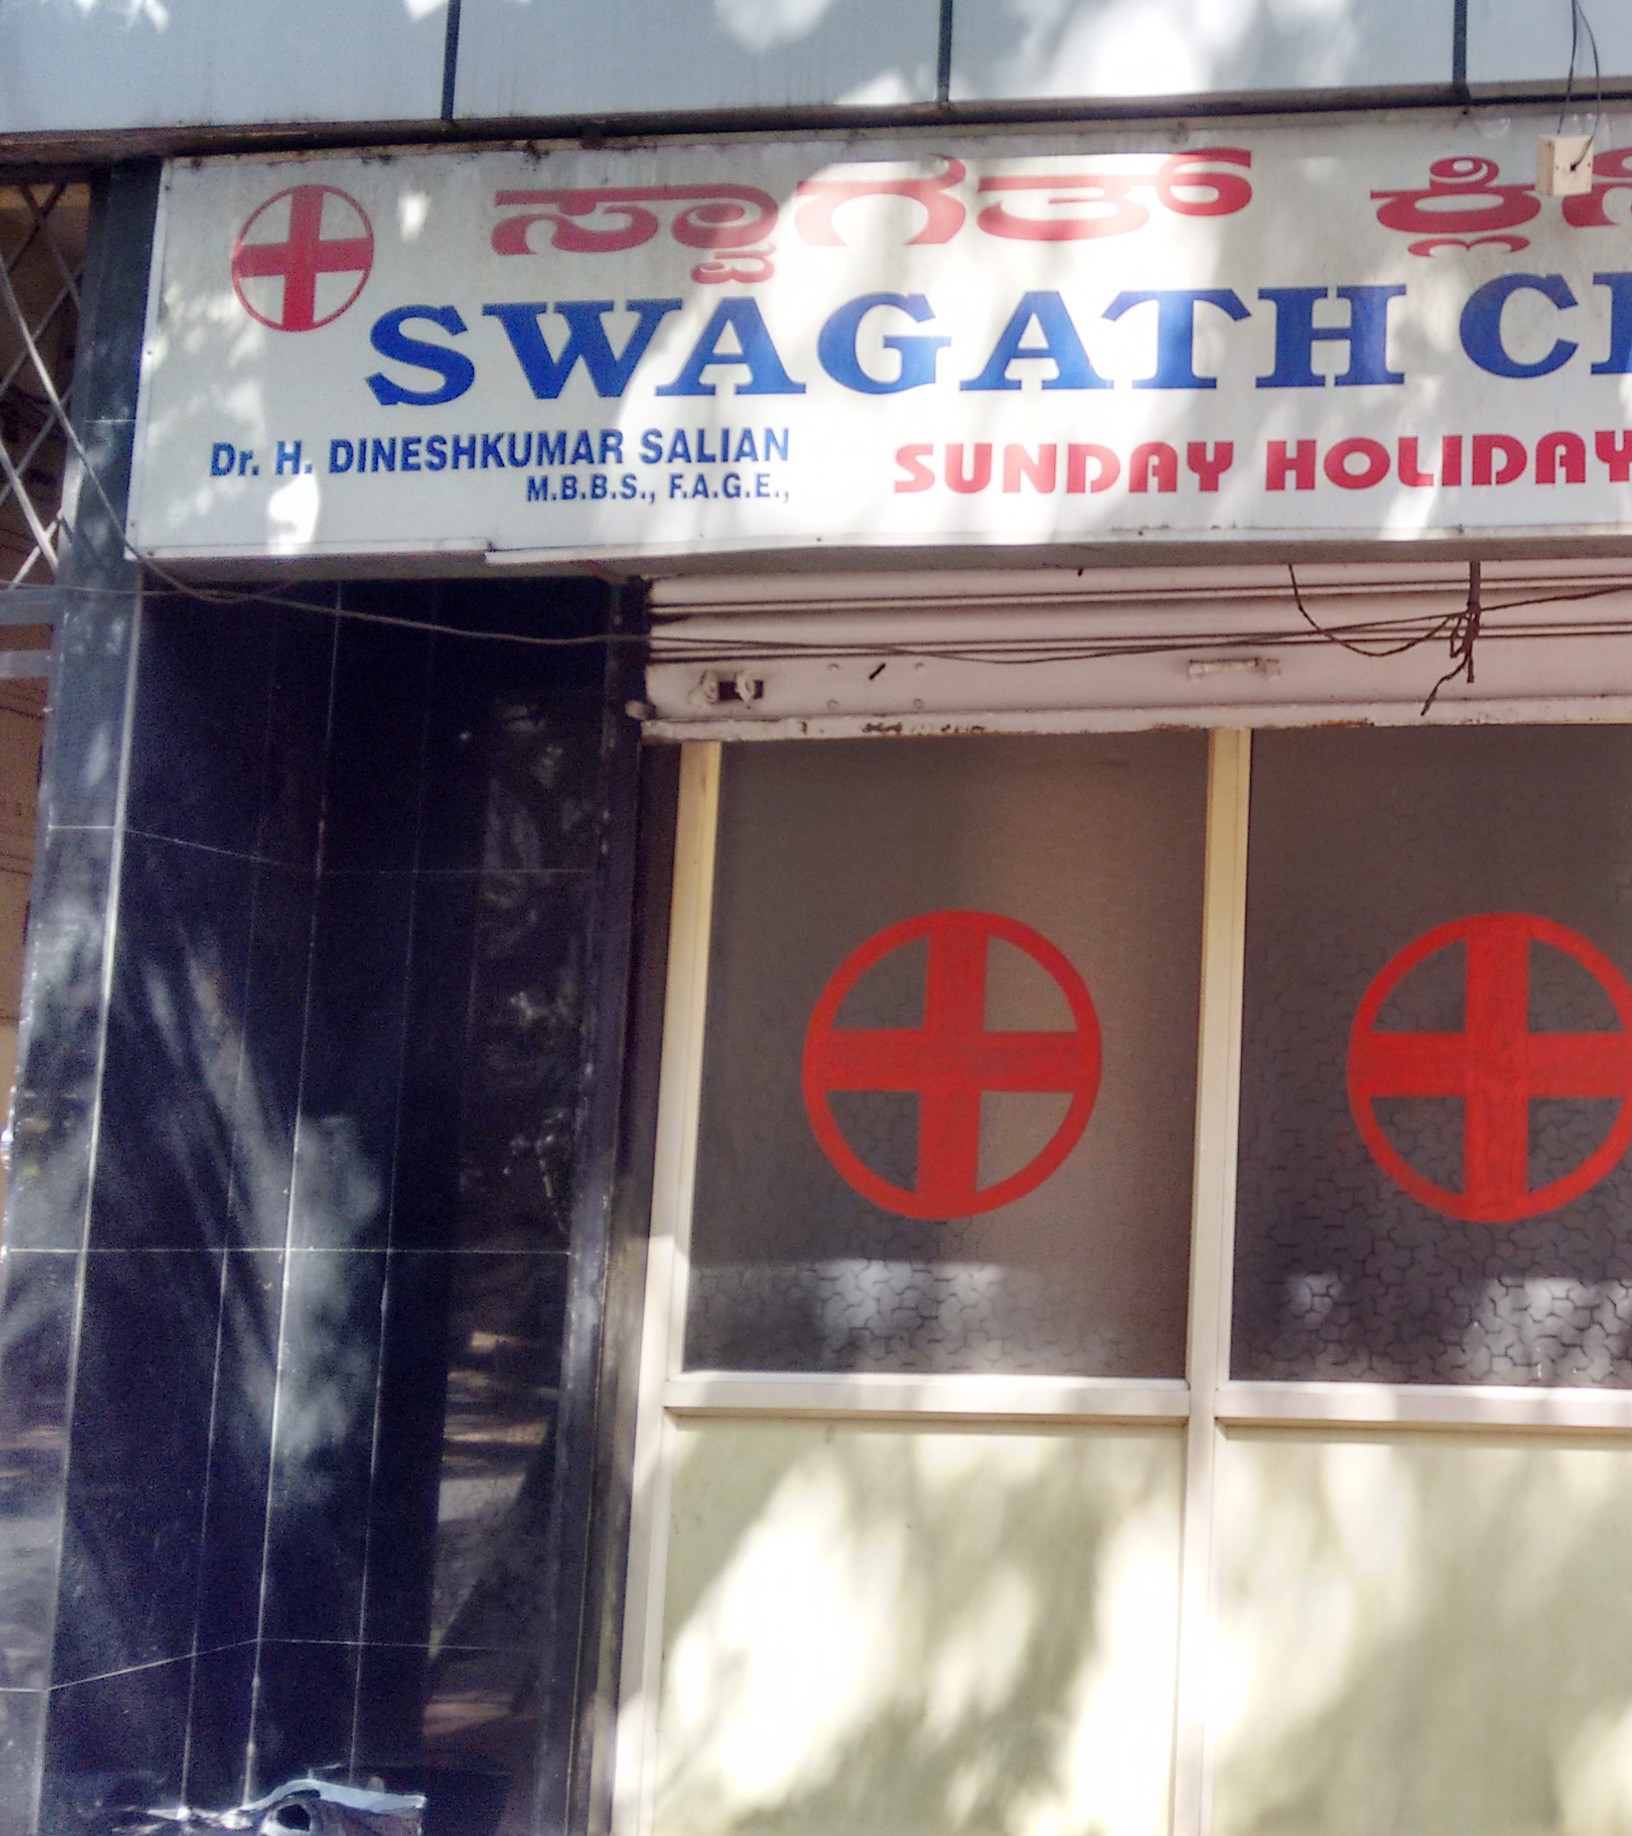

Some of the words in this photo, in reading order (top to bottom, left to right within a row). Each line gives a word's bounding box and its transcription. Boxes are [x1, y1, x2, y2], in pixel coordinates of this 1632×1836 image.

[366, 284, 1406, 406] SWAGATH
[210, 443, 259, 476] Dr.
[275, 440, 313, 475] H.
[329, 429, 624, 474] DINESHKUMAR
[638, 427, 789, 464] SALIAN
[894, 439, 1235, 494] SUNDAY
[526, 472, 656, 504] M.B.B.S.,
